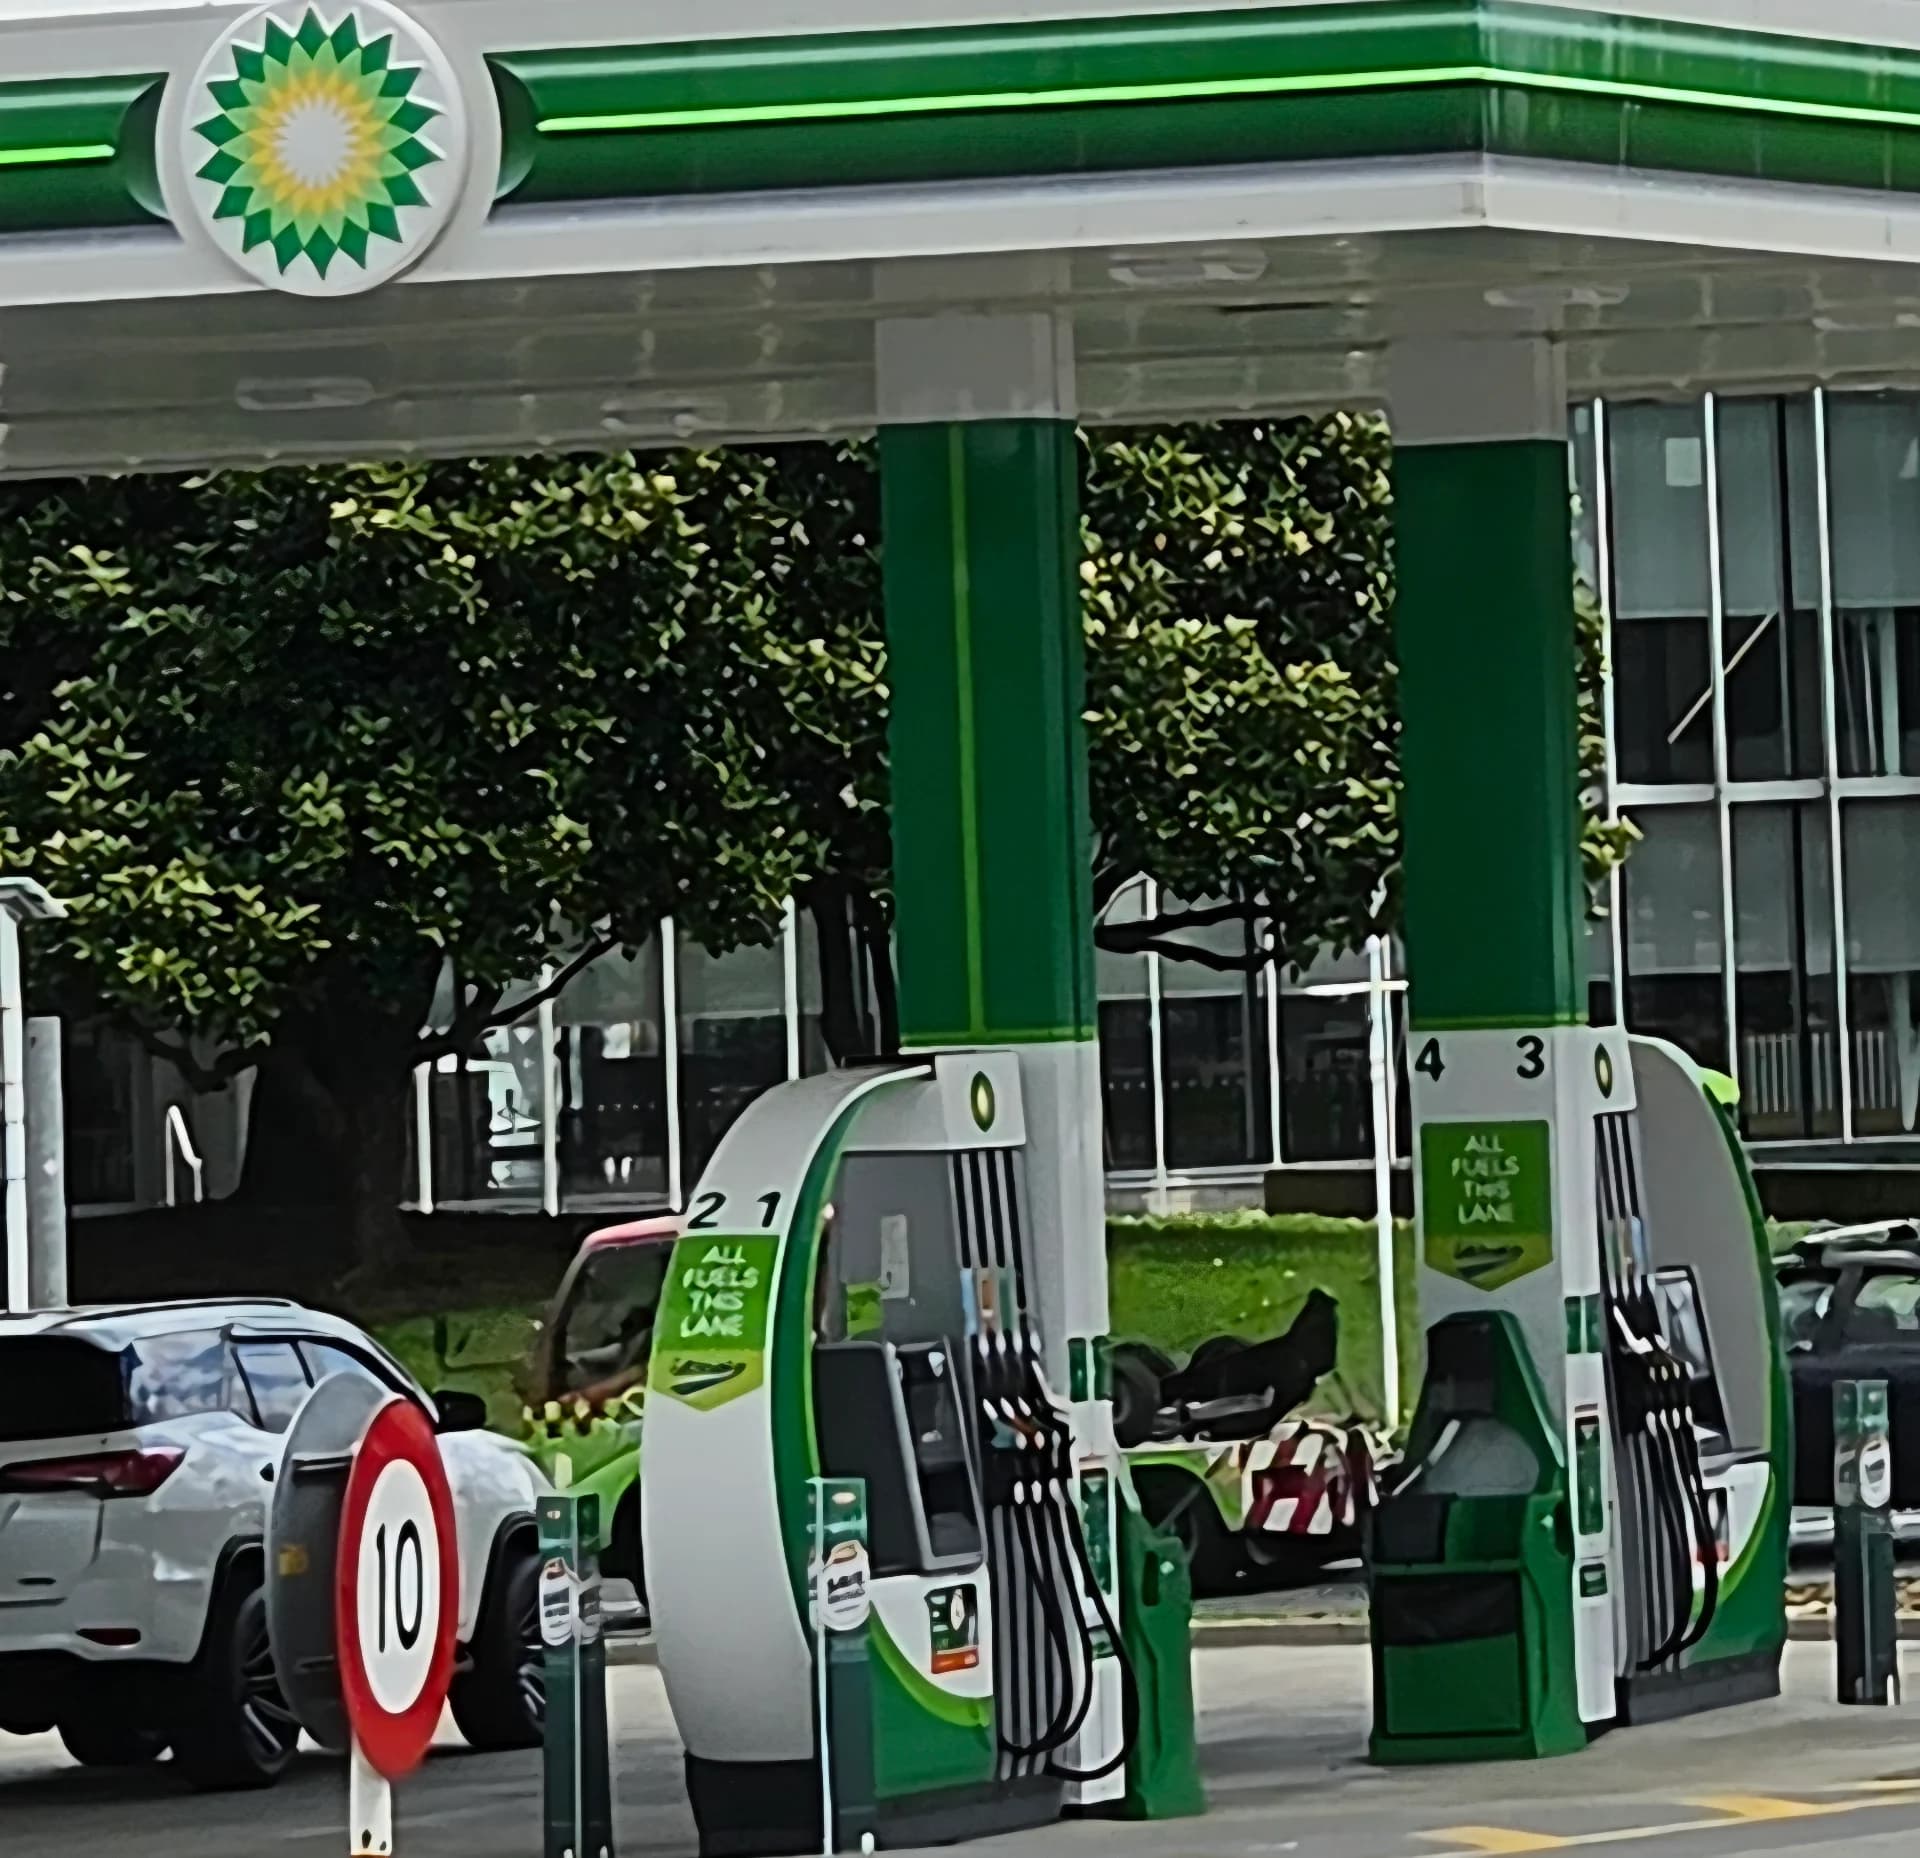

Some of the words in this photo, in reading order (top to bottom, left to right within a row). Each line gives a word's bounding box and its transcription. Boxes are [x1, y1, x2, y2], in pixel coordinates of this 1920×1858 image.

[1414, 1037, 1445, 1082] 4
[1516, 1035, 1545, 1078] 3
[1464, 1135, 1504, 1153] ALL
[687, 1192, 727, 1229] 2
[757, 1191, 781, 1228] 1
[701, 1245, 747, 1265] ALL
[376, 1518, 423, 1653] 10
